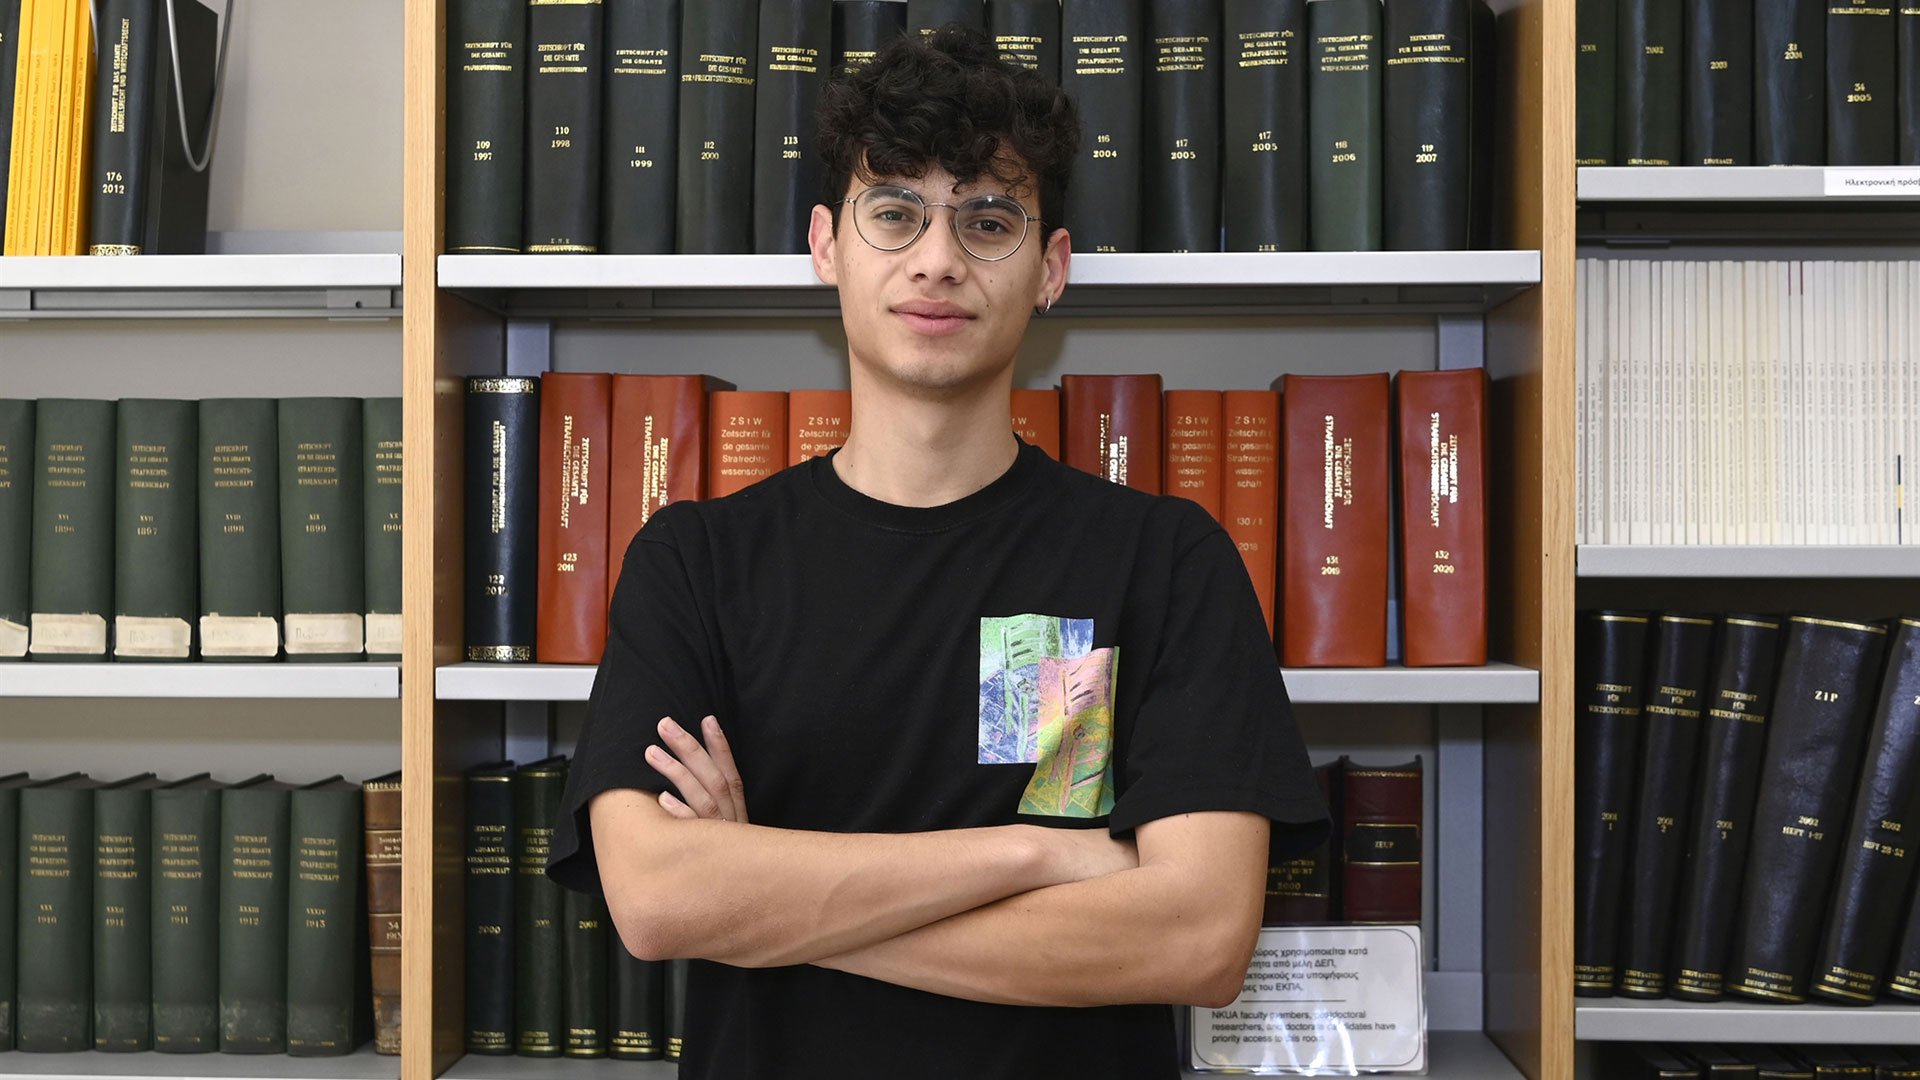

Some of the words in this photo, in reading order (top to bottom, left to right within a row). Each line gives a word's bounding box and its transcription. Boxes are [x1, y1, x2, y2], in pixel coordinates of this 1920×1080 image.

[1281, 30, 1294, 38] FÜR
[573, 43, 585, 51] FÜR
[700, 55, 734, 63] ZEITSCHRIFT
[735, 57, 747, 65] FÜR
[718, 65, 743, 74] GESAMTE
[1710, 61, 1728, 69] 2003
[1075, 67, 1125, 75] WISSENSCHAFT
[1854, 83, 1865, 91] 34
[1847, 94, 1872, 102] 2005
[555, 127, 570, 135] 110
[1258, 131, 1272, 140] 117
[783, 137, 798, 145] 113
[1097, 135, 1110, 143] 116
[1175, 139, 1189, 148] 117
[476, 141, 491, 149] 109
[551, 140, 571, 148] 1998
[1252, 143, 1278, 152] 2005
[1335, 141, 1348, 149] 118
[473, 153, 492, 161] 1997
[701, 152, 720, 160] 2000
[782, 151, 801, 159] 2001
[1093, 151, 1118, 159] 2004
[1170, 151, 1196, 160] 2005
[1332, 154, 1356, 162] 2006
[1416, 154, 1437, 163] 2007
[106, 172, 122, 182] 176
[1845, 179, 1896, 187] Ηλεκτρονική
[102, 184, 125, 194] 2012
[721, 430, 759, 438] Zeitschrift
[652, 445, 660, 458] DIE
[1440, 443, 1449, 456] DIE
[581, 438, 590, 488] ZEITSCHRIFT
[660, 438, 669, 489] ZEITSCHRIFT
[1343, 438, 1352, 487] ZEITSCHRIFT
[1177, 468, 1208, 476] wissen-
[1235, 468, 1265, 476] wissen-
[571, 460, 580, 497] GESAMTE
[651, 460, 660, 498] GESAMTE
[1334, 460, 1343, 498] GESAMTE
[1440, 458, 1449, 496] GESAMTE
[1179, 479, 1205, 488] schaft
[1237, 479, 1262, 488] schaft
[580, 489, 589, 505] FÜR
[1343, 490, 1353, 506] FÜR
[1236, 517, 1251, 525] 130
[137, 527, 158, 535] 1897
[223, 525, 244, 533] 1898
[1238, 543, 1258, 551] 2018
[562, 553, 578, 562] 123
[1435, 551, 1450, 559] 132
[1326, 556, 1339, 564] 131
[557, 563, 575, 572] 2011
[1321, 567, 1341, 575] 2019
[1433, 565, 1455, 573] 2020
[489, 575, 505, 584] 122
[1660, 686, 1697, 697] ZEITSCHRIFT
[1721, 690, 1757, 702] ZEITSCHRIFT
[1608, 694, 1620, 702] FÜR
[1671, 696, 1684, 704] FÜR
[1732, 702, 1745, 711] FÜR
[1798, 816, 1819, 827] 2002
[1881, 821, 1902, 832] 2002
[1721, 832, 1727, 840] 3
[1782, 826, 1805, 837] HEFT
[1863, 840, 1880, 851] HEFT
[37, 916, 57, 924] 1910
[306, 920, 326, 928] 1913
[478, 926, 501, 934] 2000
[1280, 948, 1346, 958] χρησιμοποιείται
[1272, 960, 1291, 968] από
[1292, 960, 1312, 969] μέλη
[1314, 960, 1336, 968] ΔΕΠ,
[1306, 972, 1359, 981] υποψήφιους
[1240, 1012, 1268, 1021] faculty
[1212, 1023, 1264, 1032] researchers,
[1375, 1023, 1396, 1031] have
[1212, 1035, 1240, 1044] priority
[1275, 1035, 1282, 1043] to
